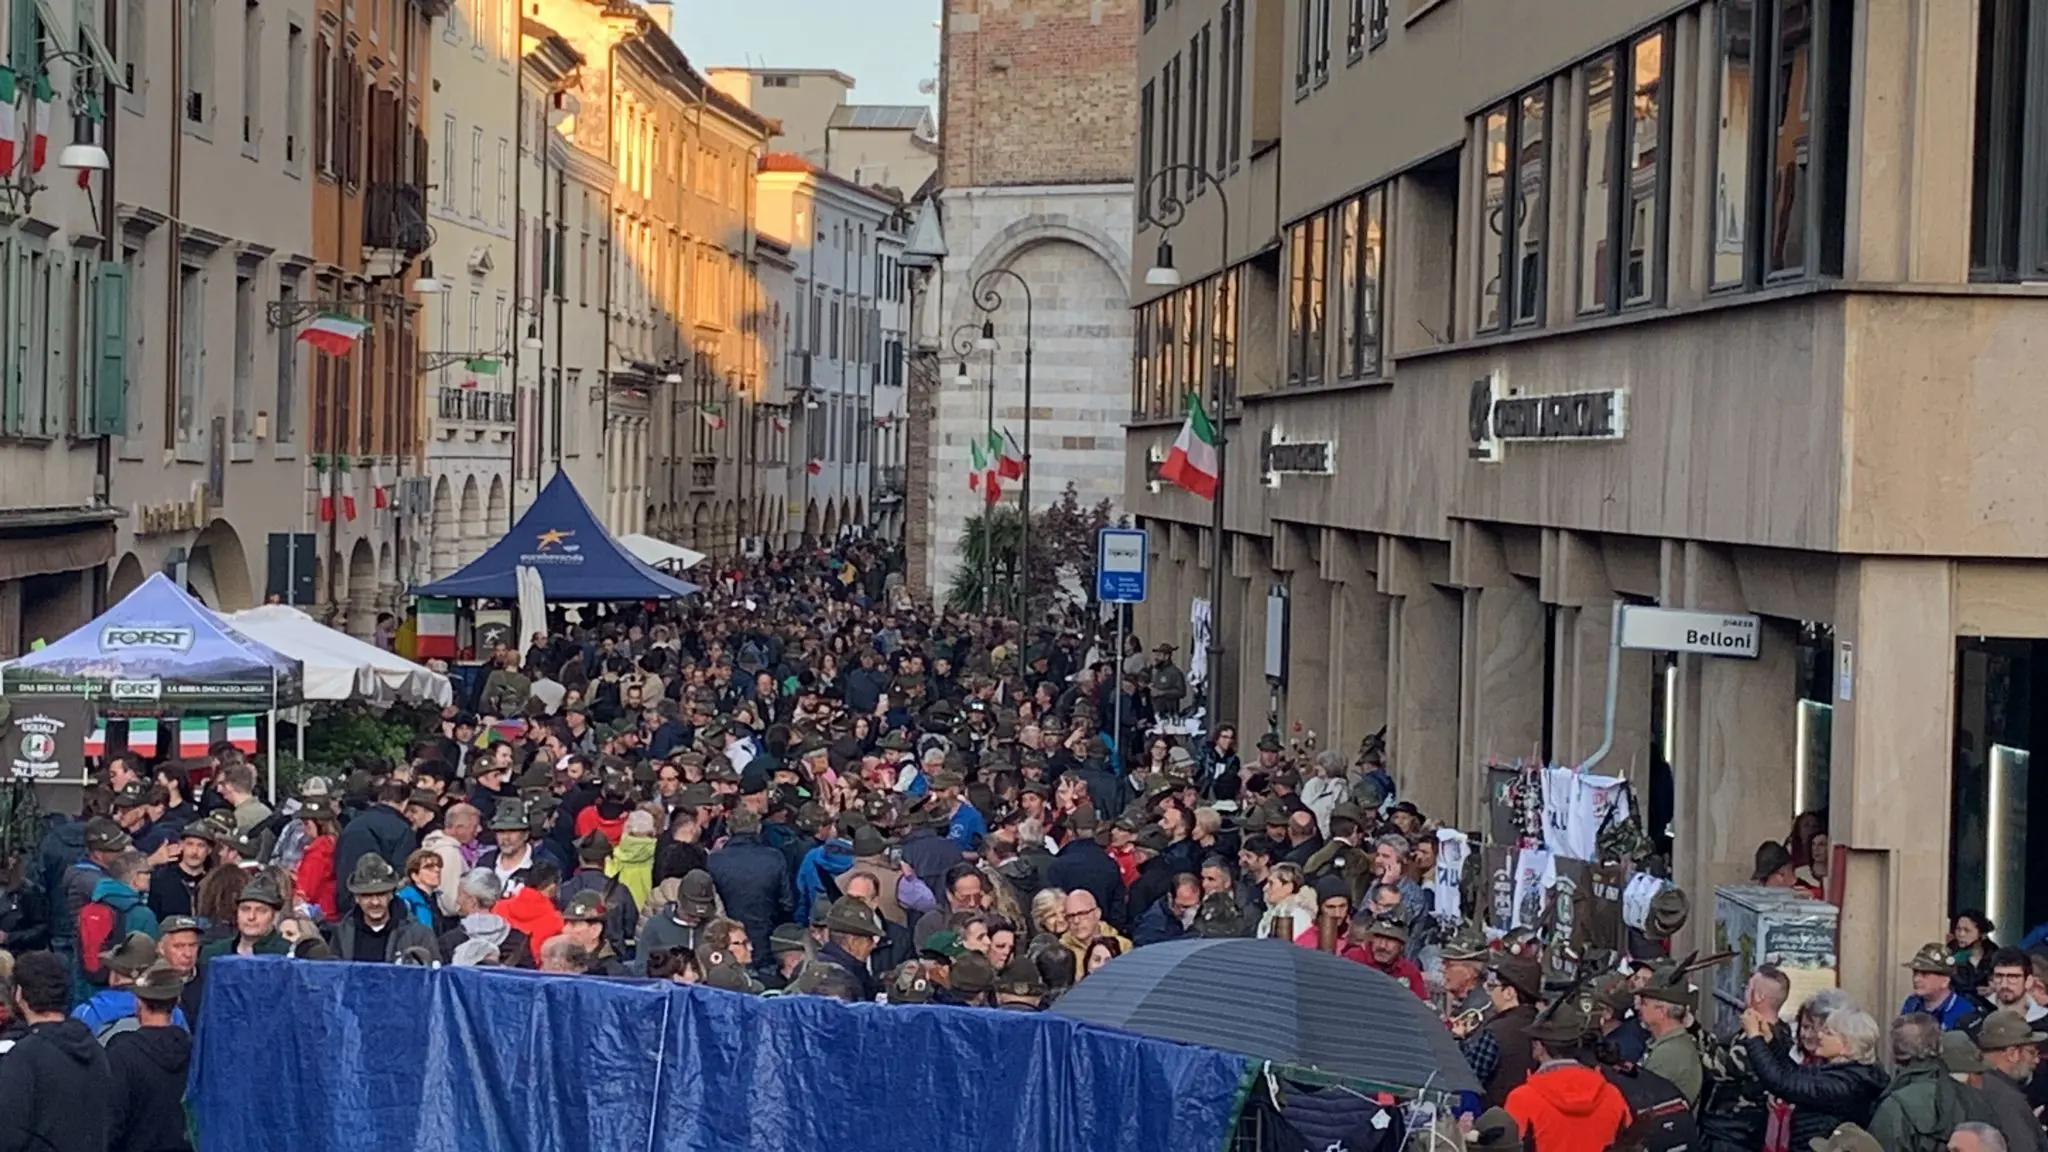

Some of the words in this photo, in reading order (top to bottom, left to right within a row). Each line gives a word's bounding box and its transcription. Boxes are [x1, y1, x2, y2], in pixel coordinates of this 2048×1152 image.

[107, 631, 188, 645] FORST
[1687, 629, 1752, 648] Belloni
[116, 683, 155, 694] FORST
